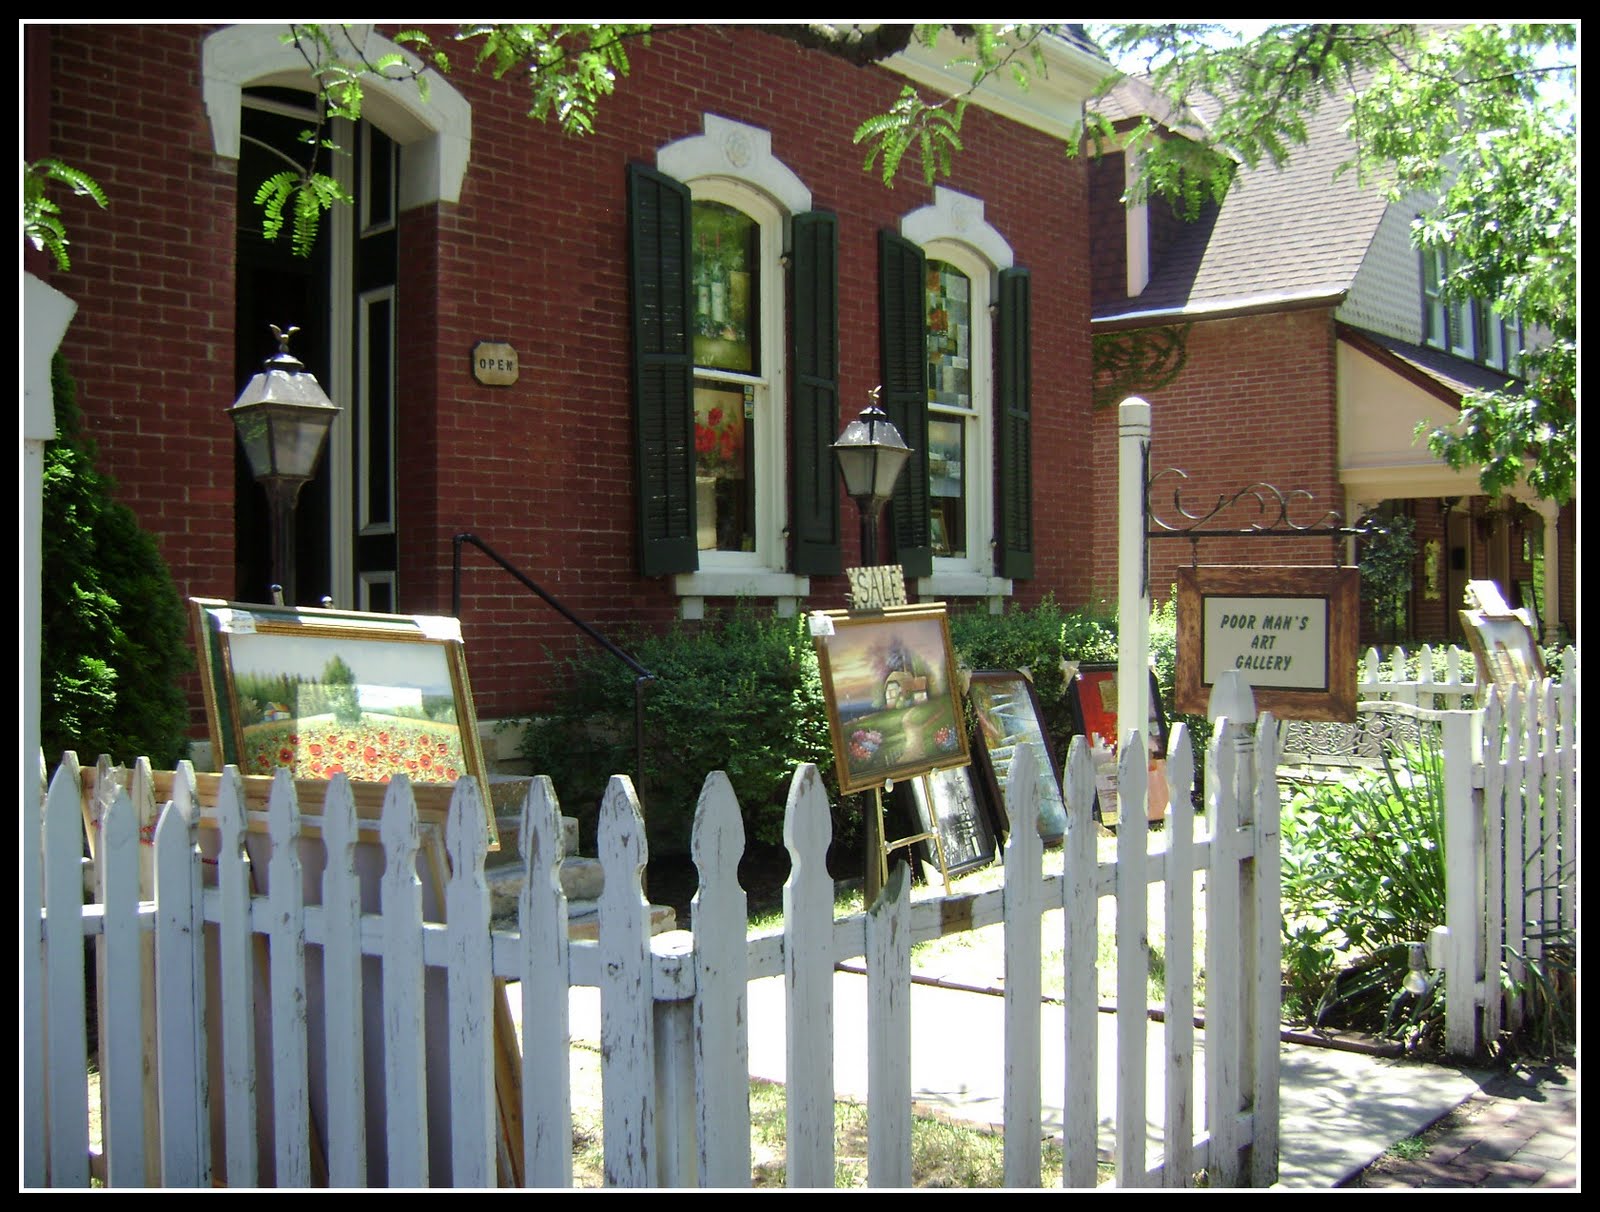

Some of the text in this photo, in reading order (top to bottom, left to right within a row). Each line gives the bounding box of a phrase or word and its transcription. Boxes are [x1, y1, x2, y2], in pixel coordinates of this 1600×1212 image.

[480, 359, 513, 371] OPEN
[857, 571, 900, 604] SALE
[1221, 614, 1309, 631] POOR MAN'S
[1251, 635, 1276, 650] ART
[1235, 655, 1292, 671] GALLERY
